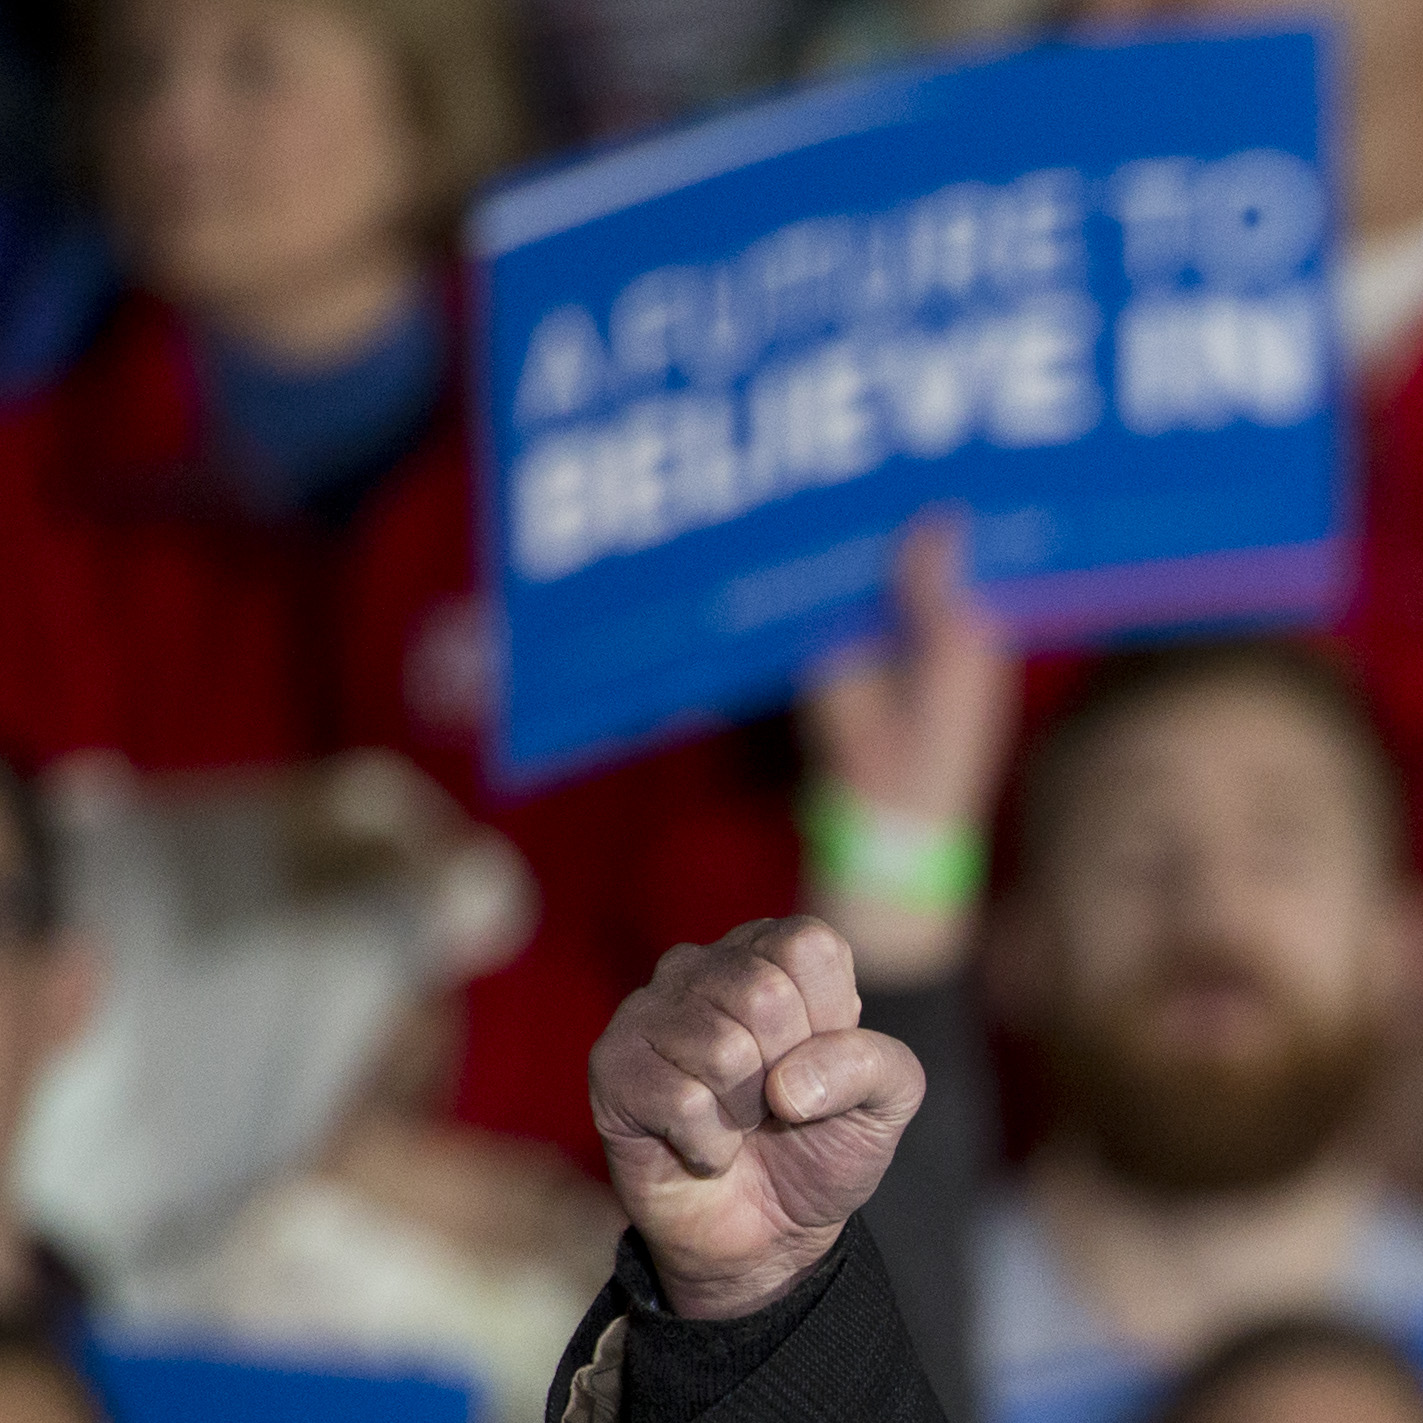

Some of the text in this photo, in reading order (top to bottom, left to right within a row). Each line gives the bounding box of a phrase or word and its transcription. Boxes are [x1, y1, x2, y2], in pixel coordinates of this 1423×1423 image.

[515, 150, 1325, 425] A FUTURE TO
[512, 288, 1103, 582] BELIEVE
[1116, 290, 1325, 433] IN
